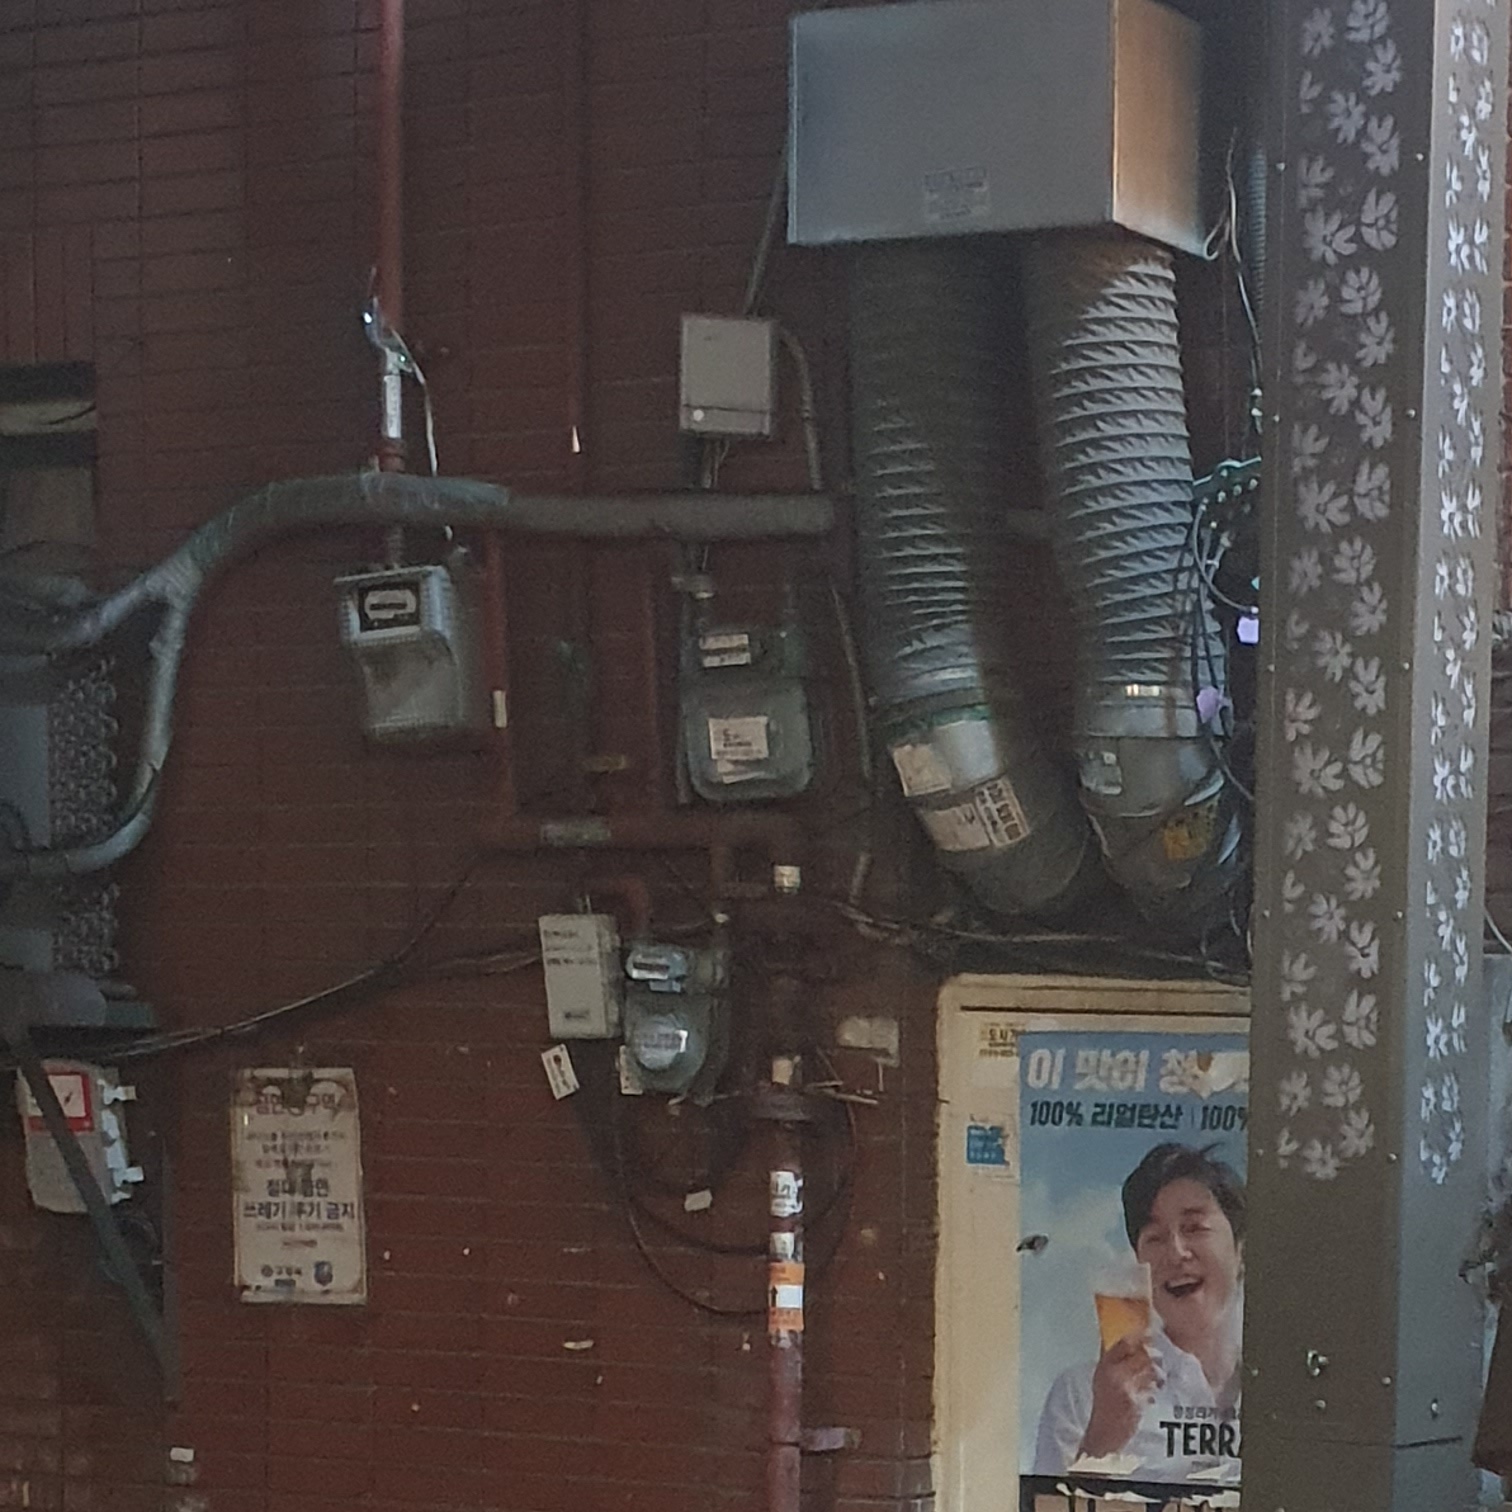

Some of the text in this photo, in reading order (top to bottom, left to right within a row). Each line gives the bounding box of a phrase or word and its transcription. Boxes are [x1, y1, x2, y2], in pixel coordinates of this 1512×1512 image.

[1026, 1048, 1064, 1091] 이
[1030, 1100, 1083, 1127] 100%
[1159, 1421, 1241, 1459] TERR
